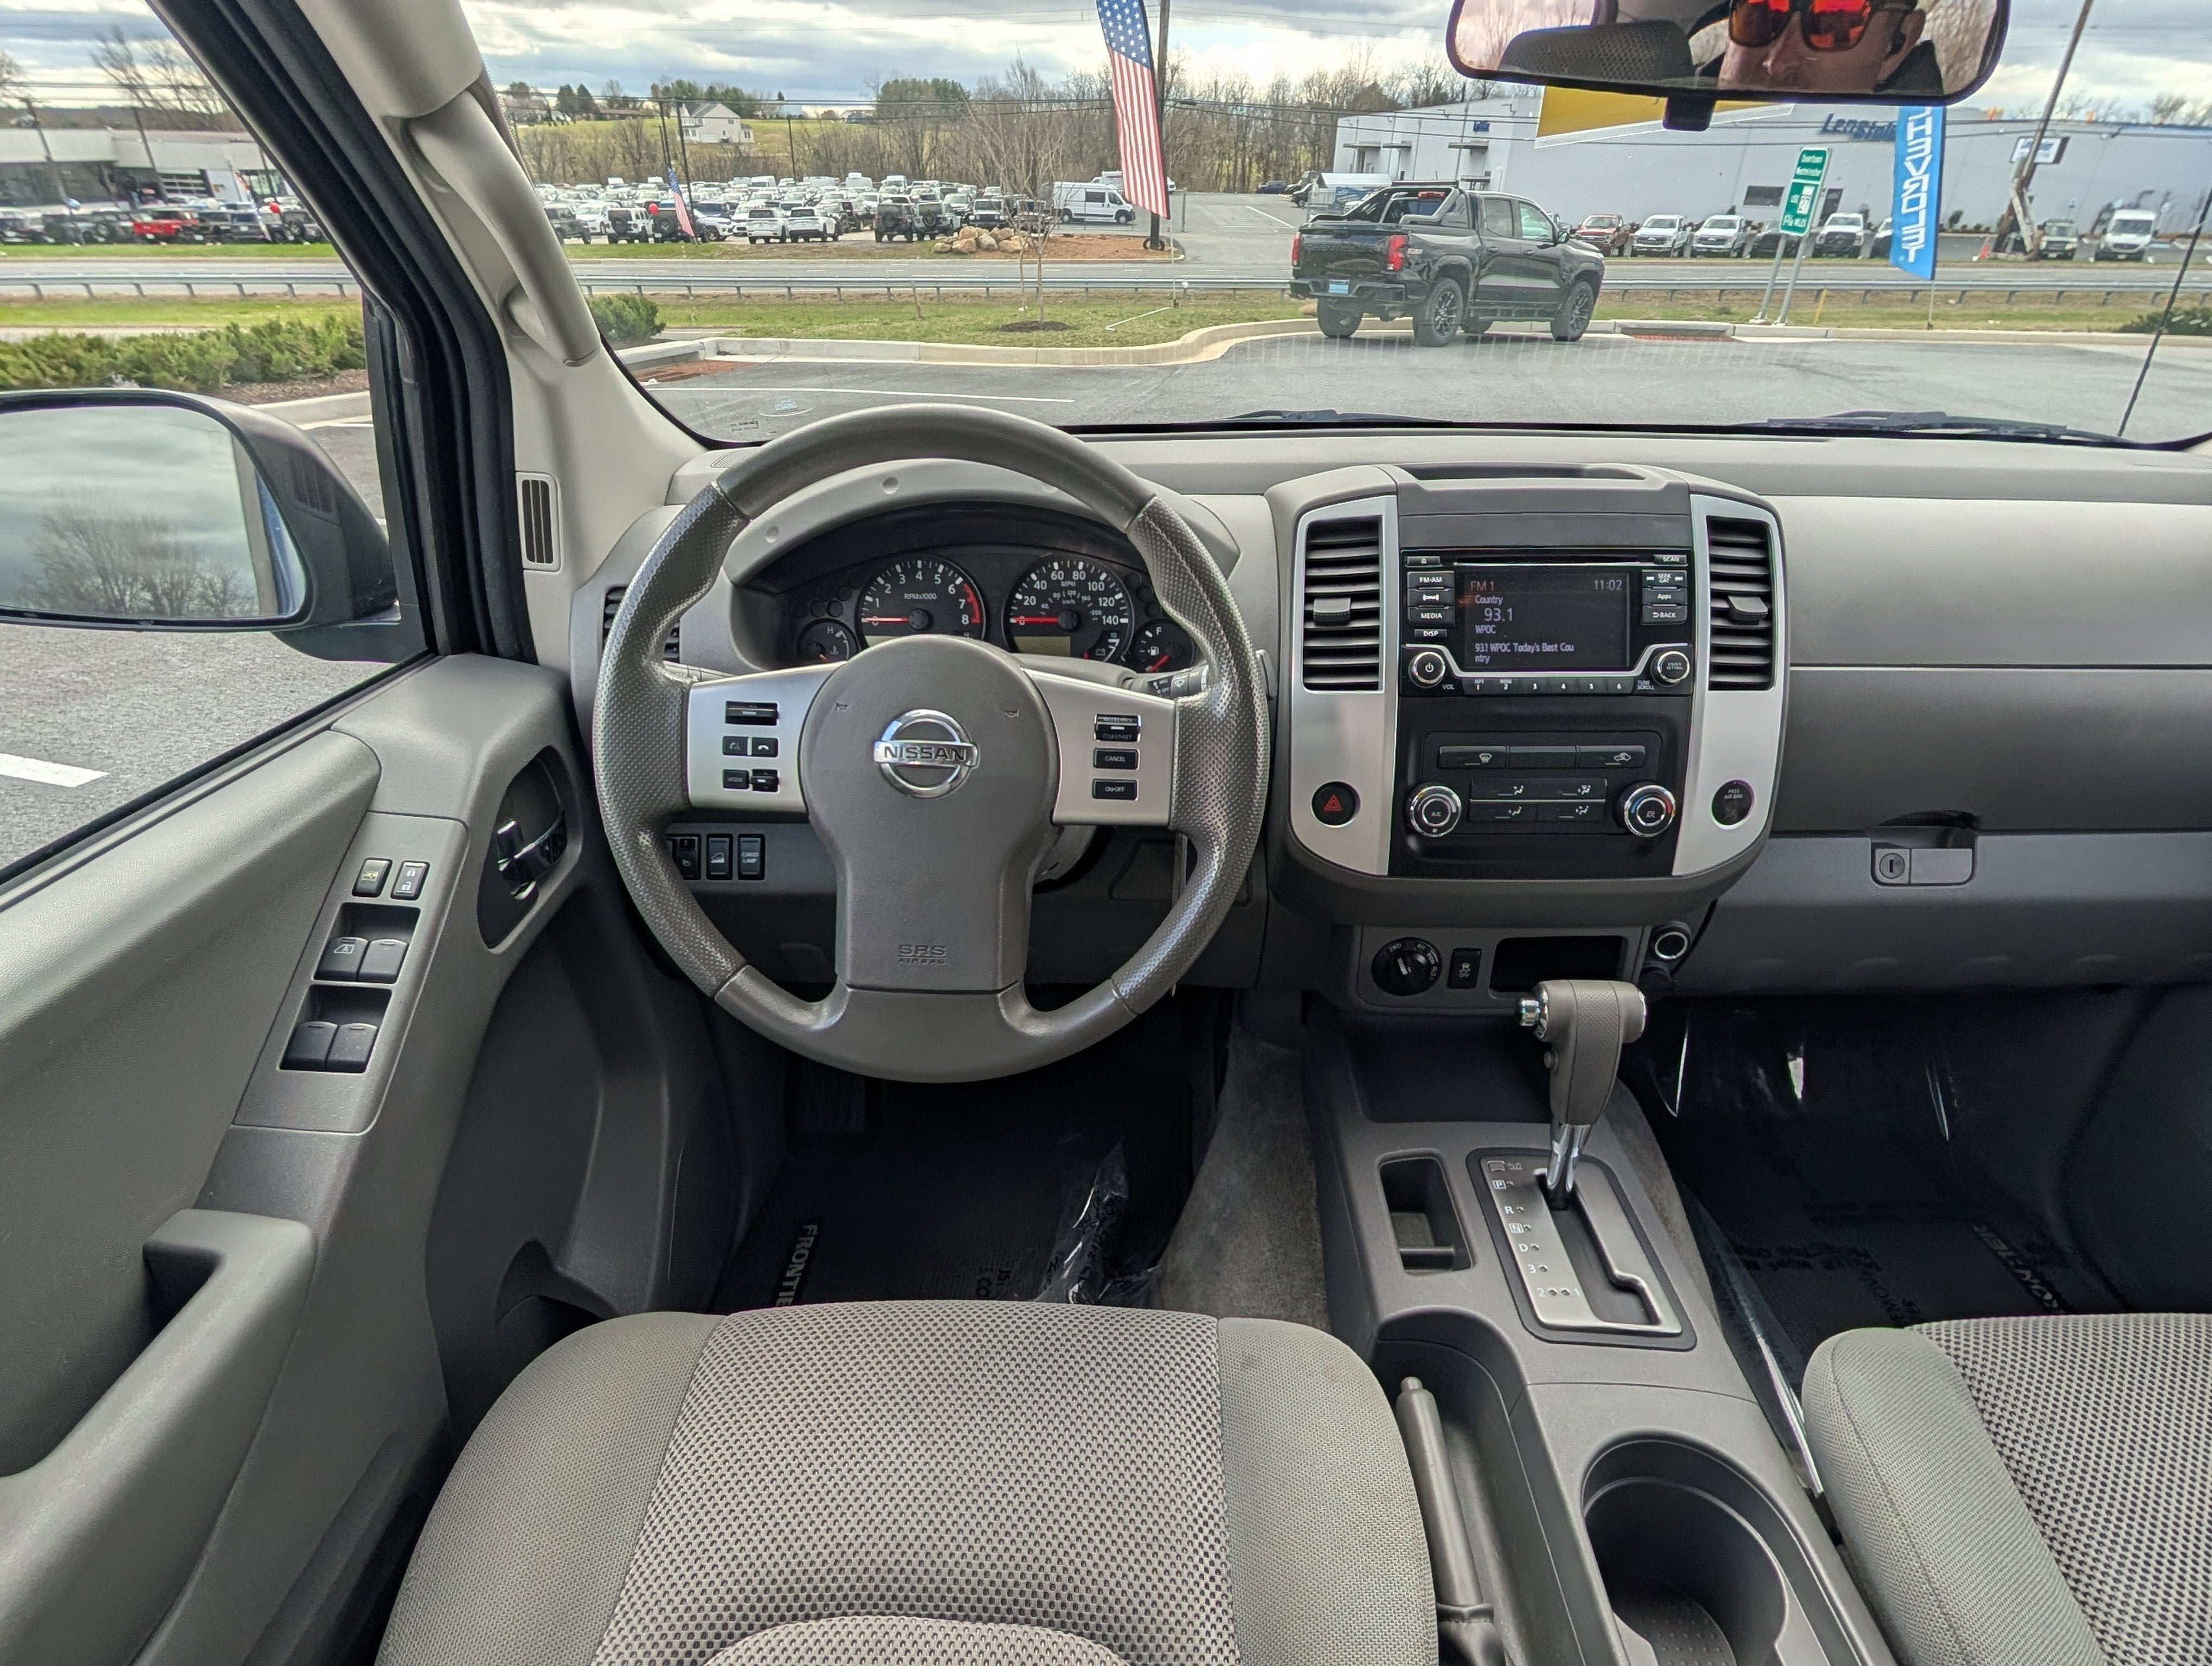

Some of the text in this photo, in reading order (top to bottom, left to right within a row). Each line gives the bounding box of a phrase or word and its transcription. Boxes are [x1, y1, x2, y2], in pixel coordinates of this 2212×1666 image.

[899, 574, 905, 584] 3
[915, 571, 923, 580] 4
[935, 574, 941, 584] 5
[1051, 571, 1064, 580] 60
[1072, 571, 1086, 580] 80
[885, 584, 891, 594] 2
[948, 584, 955, 594] 6
[1033, 580, 1047, 590] 40
[1088, 581, 1105, 591] 100
[1470, 581, 1494, 592] FM 1
[1594, 579, 1622, 591] 11:02
[874, 598, 879, 607] 1
[959, 598, 966, 609] 7
[1023, 595, 1037, 606] 20
[1098, 597, 1115, 607] 120
[1475, 594, 1503, 605] Country
[1484, 607, 1513, 621] 93.1
[961, 614, 969, 625] 8
[1102, 615, 1118, 625] 140
[1475, 625, 1496, 634] WPOC
[1490, 643, 1511, 652] WPOC
[1513, 642, 1540, 653] Today's
[1542, 642, 1558, 652] Best
[1560, 642, 1574, 652] Cou
[1475, 654, 1490, 664] ntry
[884, 746, 967, 761] NISSAN
[899, 944, 947, 956] SRS
[1504, 1206, 1514, 1215] R
[1519, 1243, 1528, 1252] D
[1527, 1264, 1536, 1273] 3
[1536, 1288, 1580, 1298] 2 1
